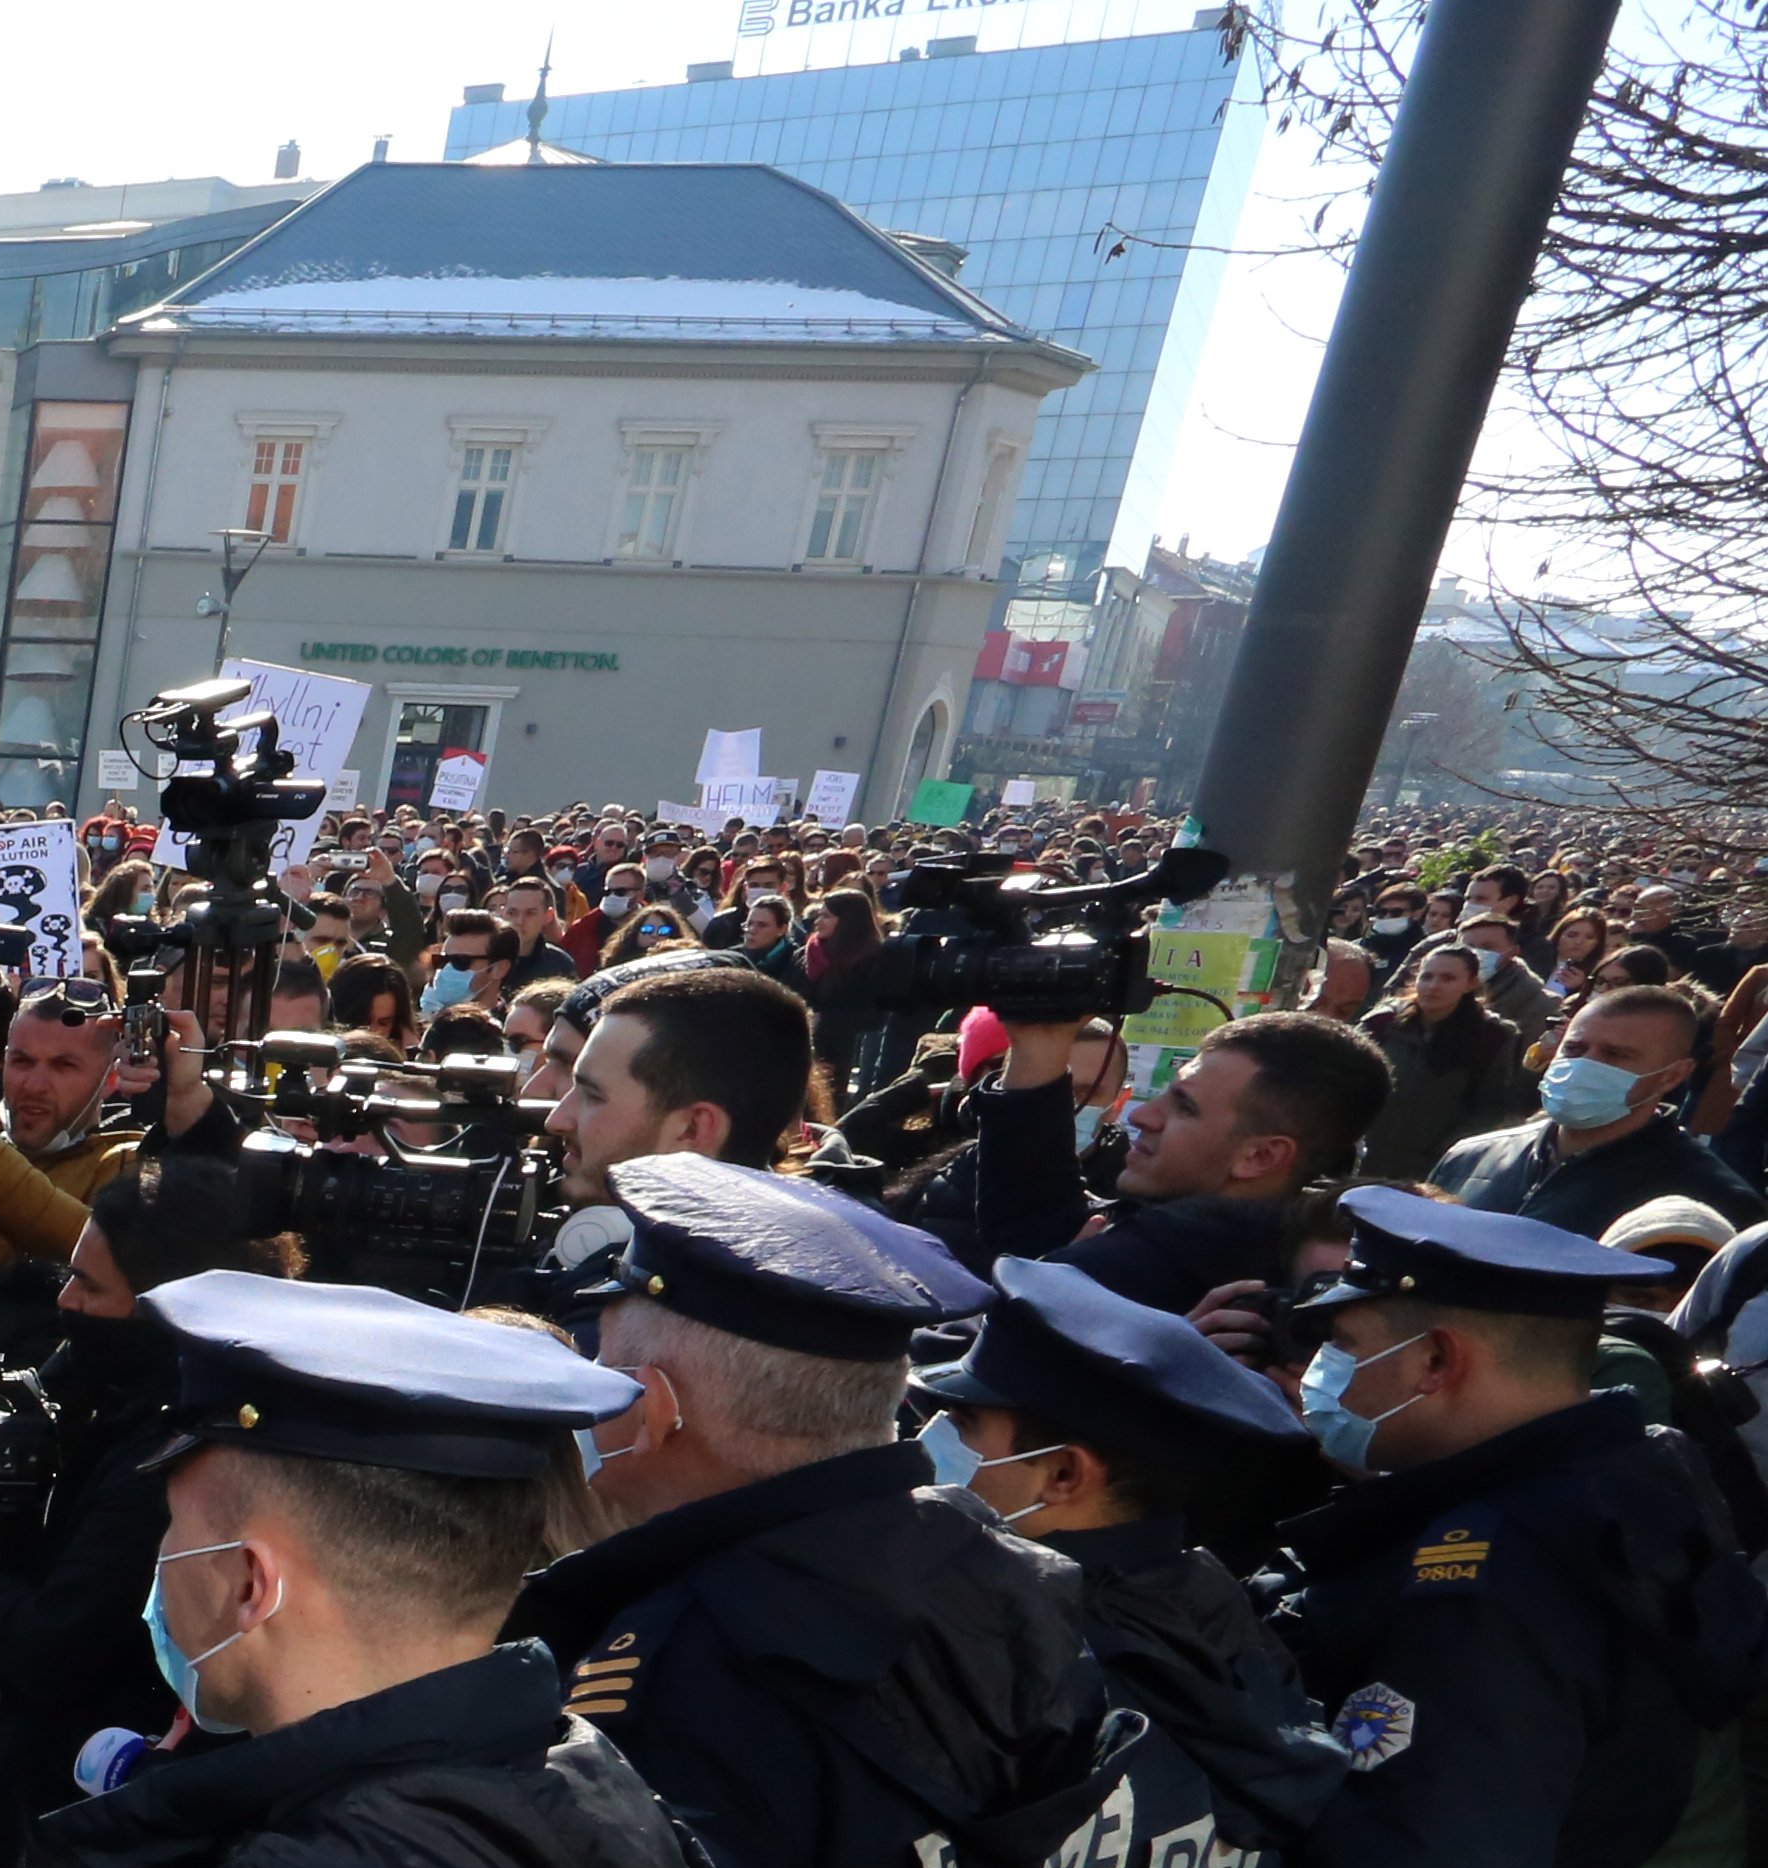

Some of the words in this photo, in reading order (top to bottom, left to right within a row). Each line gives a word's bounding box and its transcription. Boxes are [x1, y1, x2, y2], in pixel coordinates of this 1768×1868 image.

[787, 0, 904, 28] Banka
[300, 641, 379, 663] UNITED
[382, 644, 469, 667] COLORS
[471, 647, 505, 668] OF
[505, 648, 621, 672] BENETTON.
[21, 836, 48, 848] AIR
[1416, 1563, 1479, 1583] 9804
